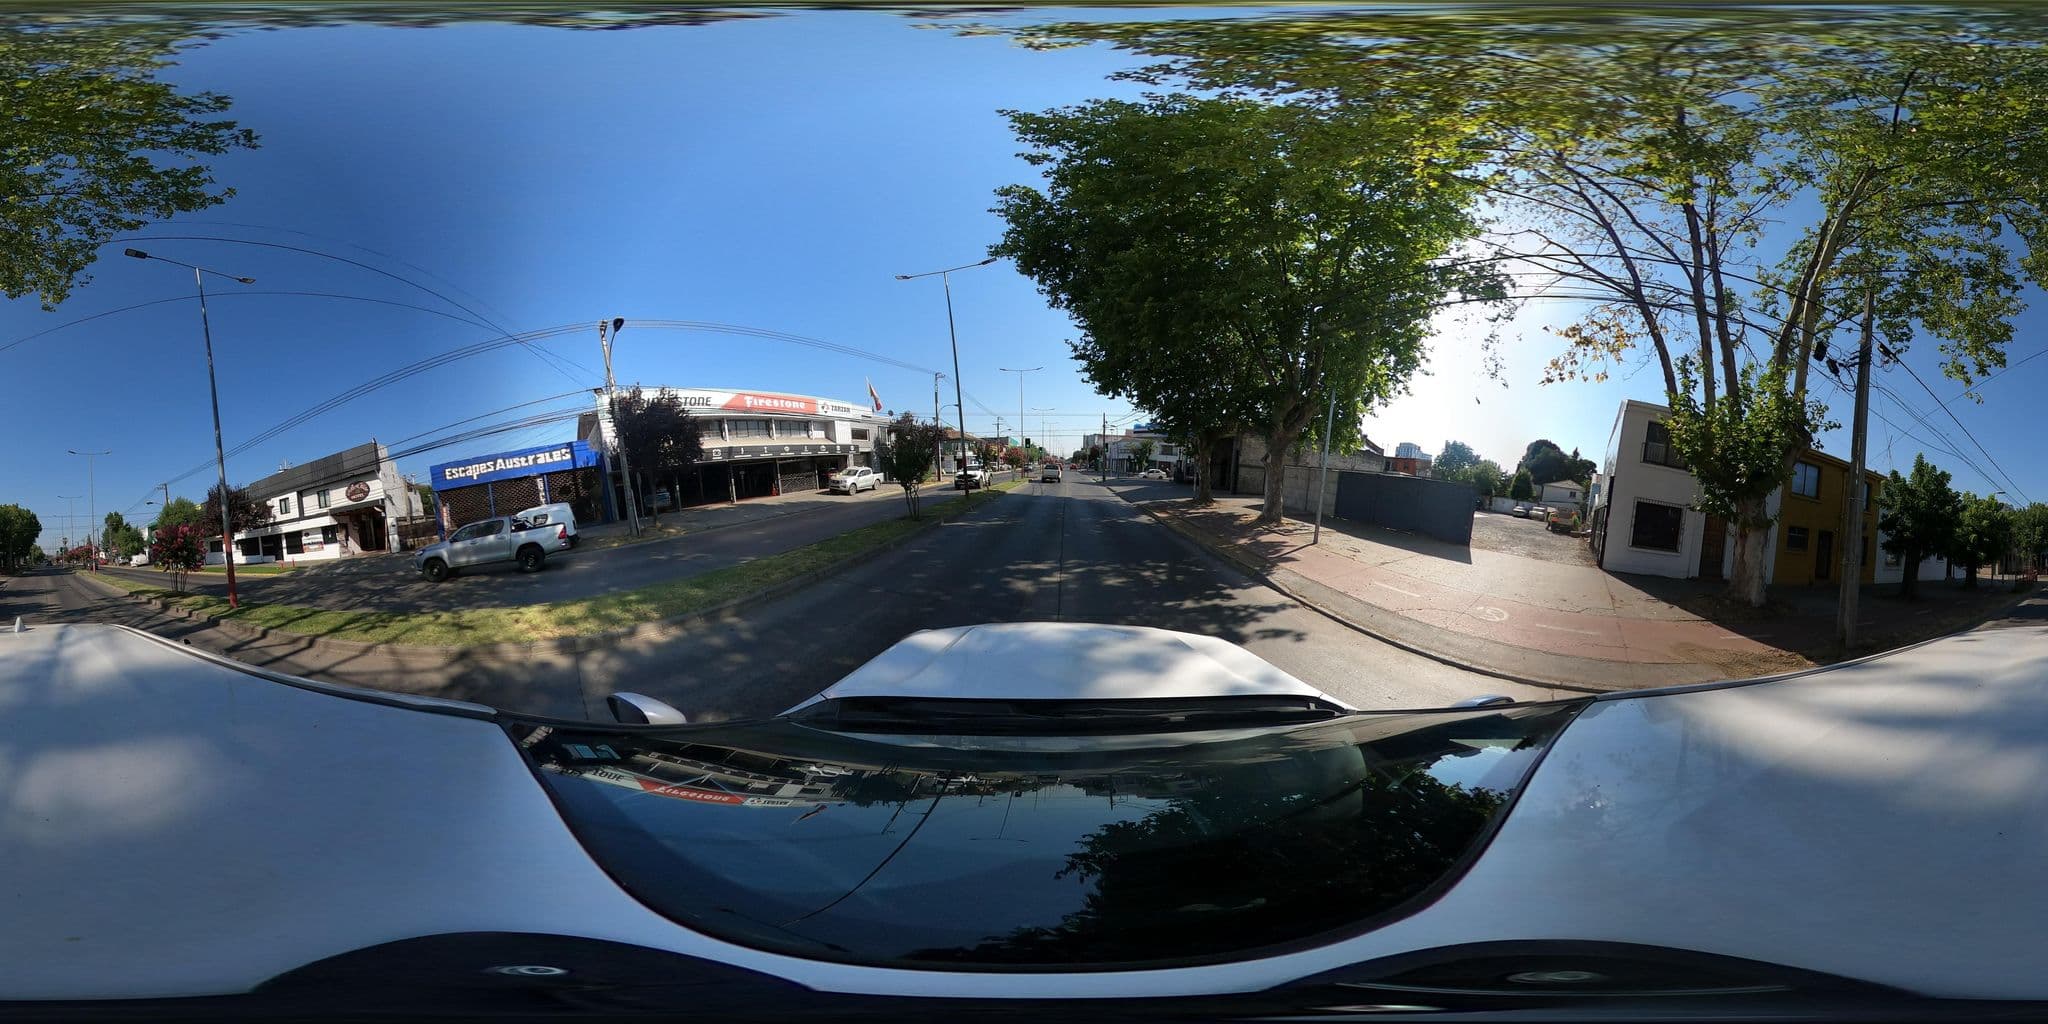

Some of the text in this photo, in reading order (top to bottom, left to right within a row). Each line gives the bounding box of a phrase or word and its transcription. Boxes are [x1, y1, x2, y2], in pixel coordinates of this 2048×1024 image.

[744, 395, 806, 409] Firestone
[445, 448, 572, 480] Escapes Australes
